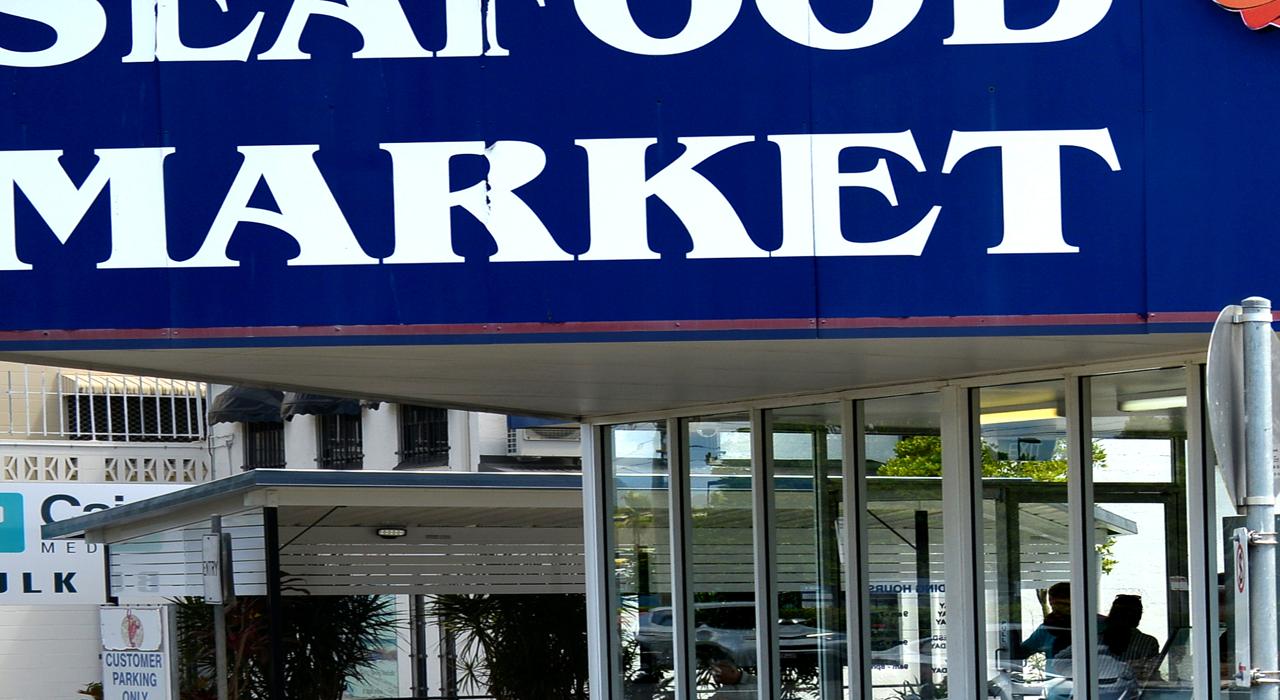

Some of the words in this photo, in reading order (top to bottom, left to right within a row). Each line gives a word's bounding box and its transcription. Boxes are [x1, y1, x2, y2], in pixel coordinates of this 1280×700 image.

[0, 127, 1122, 271] MARKET
[105, 653, 163, 668] CUSTOMER
[112, 671, 158, 687] PARKING
[121, 690, 149, 700] ONLY
